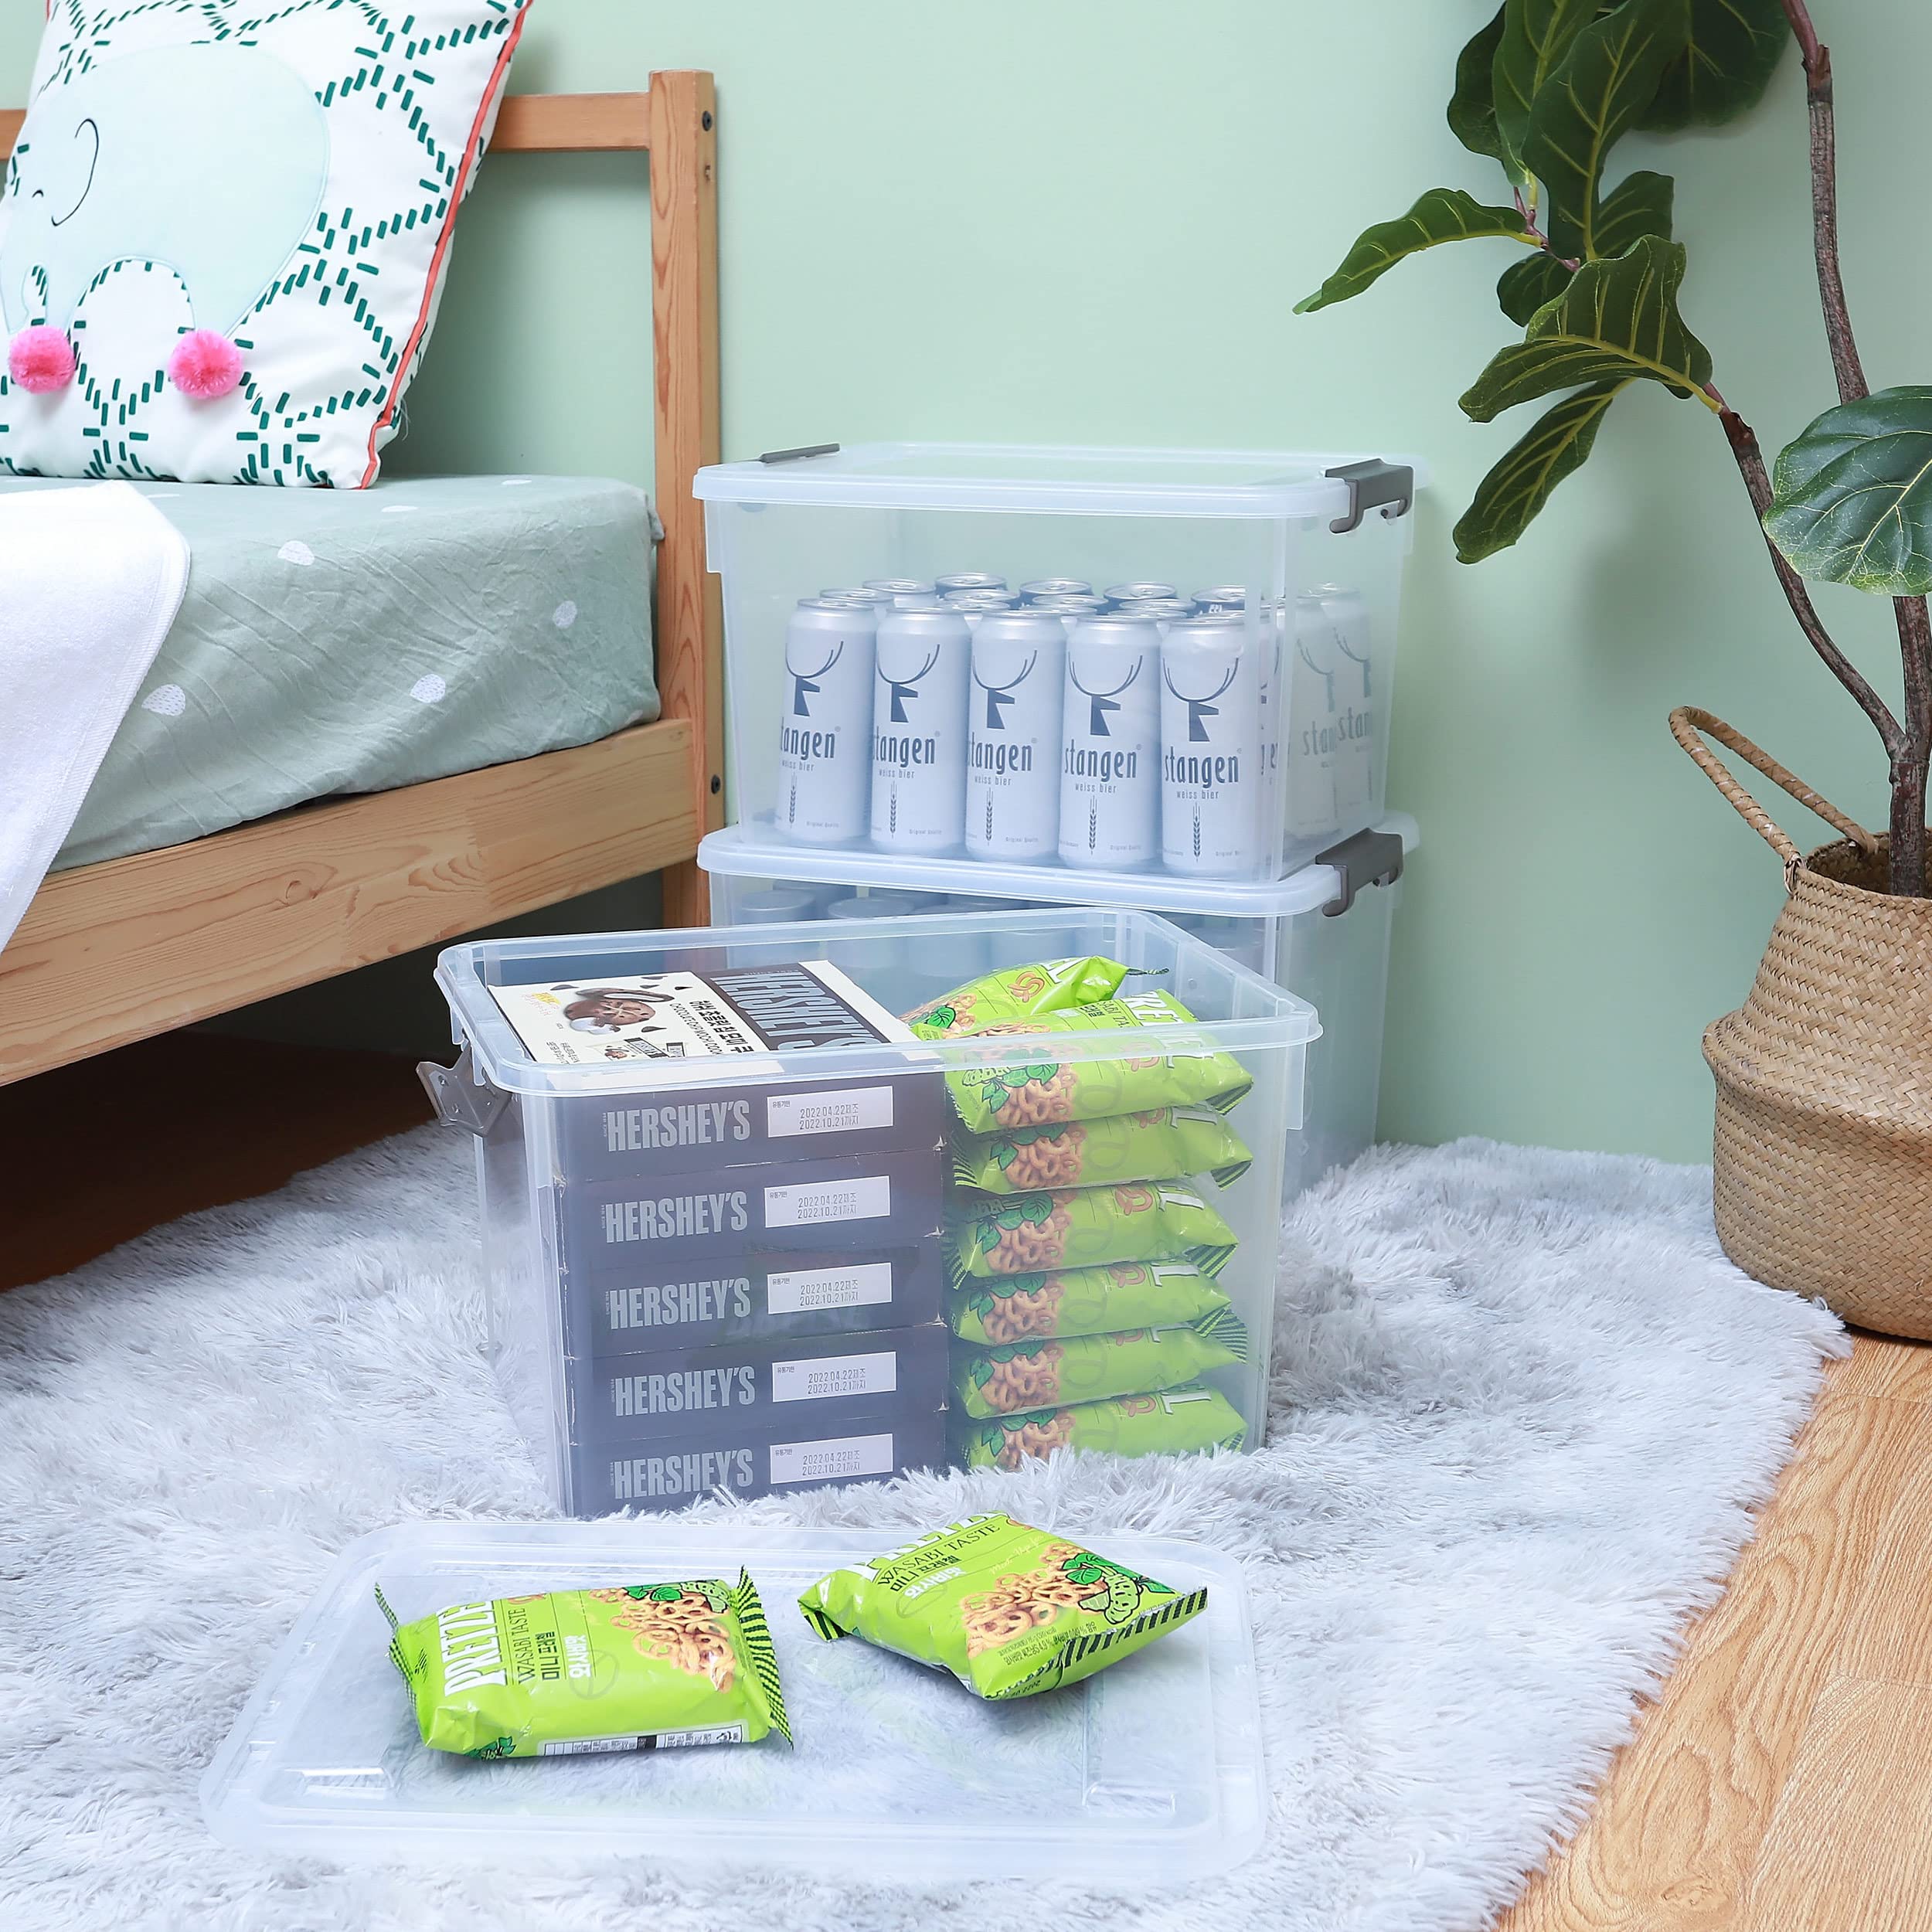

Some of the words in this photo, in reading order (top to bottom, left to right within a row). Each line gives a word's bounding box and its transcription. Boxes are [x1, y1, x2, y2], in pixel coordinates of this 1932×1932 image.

[781, 717, 835, 760] tangen
[872, 726, 935, 767] tangen
[1303, 720, 1335, 756] stan
[798, 762, 815, 771] bier
[879, 769, 895, 777] weiss
[899, 769, 914, 779] bier
[975, 775, 992, 784] weiss
[995, 776, 1011, 785] bier
[1065, 739, 1137, 783] stangen
[1165, 746, 1239, 789] stangen
[1075, 783, 1095, 792] weiss
[1100, 784, 1117, 793] bier
[1176, 790, 1197, 799] weiss
[1202, 790, 1219, 799] bier
[730, 1045, 754, 1053] 쿠
[607, 1100, 750, 1152] HERSHEY'S
[605, 1191, 748, 1243] HERSHEY'S
[608, 1277, 750, 1329] HERSHEY'S
[615, 1366, 756, 1416] HERSHEY'S
[614, 1448, 753, 1499] HERSHEY'S
[878, 1549, 945, 1586] WASABI
[944, 1524, 1000, 1551] TASTE
[890, 1571, 920, 1592] 미니
[918, 1555, 961, 1573] 프레첼
[904, 1566, 967, 1599] 와사비맛
[508, 1607, 529, 1636] TASTE
[436, 1600, 507, 1697] PRETZE
[513, 1638, 536, 1685] WASABI
[535, 1631, 557, 1654] 프레첼
[564, 1634, 590, 1678] 와사비맛
[539, 1655, 560, 1680] 미니
